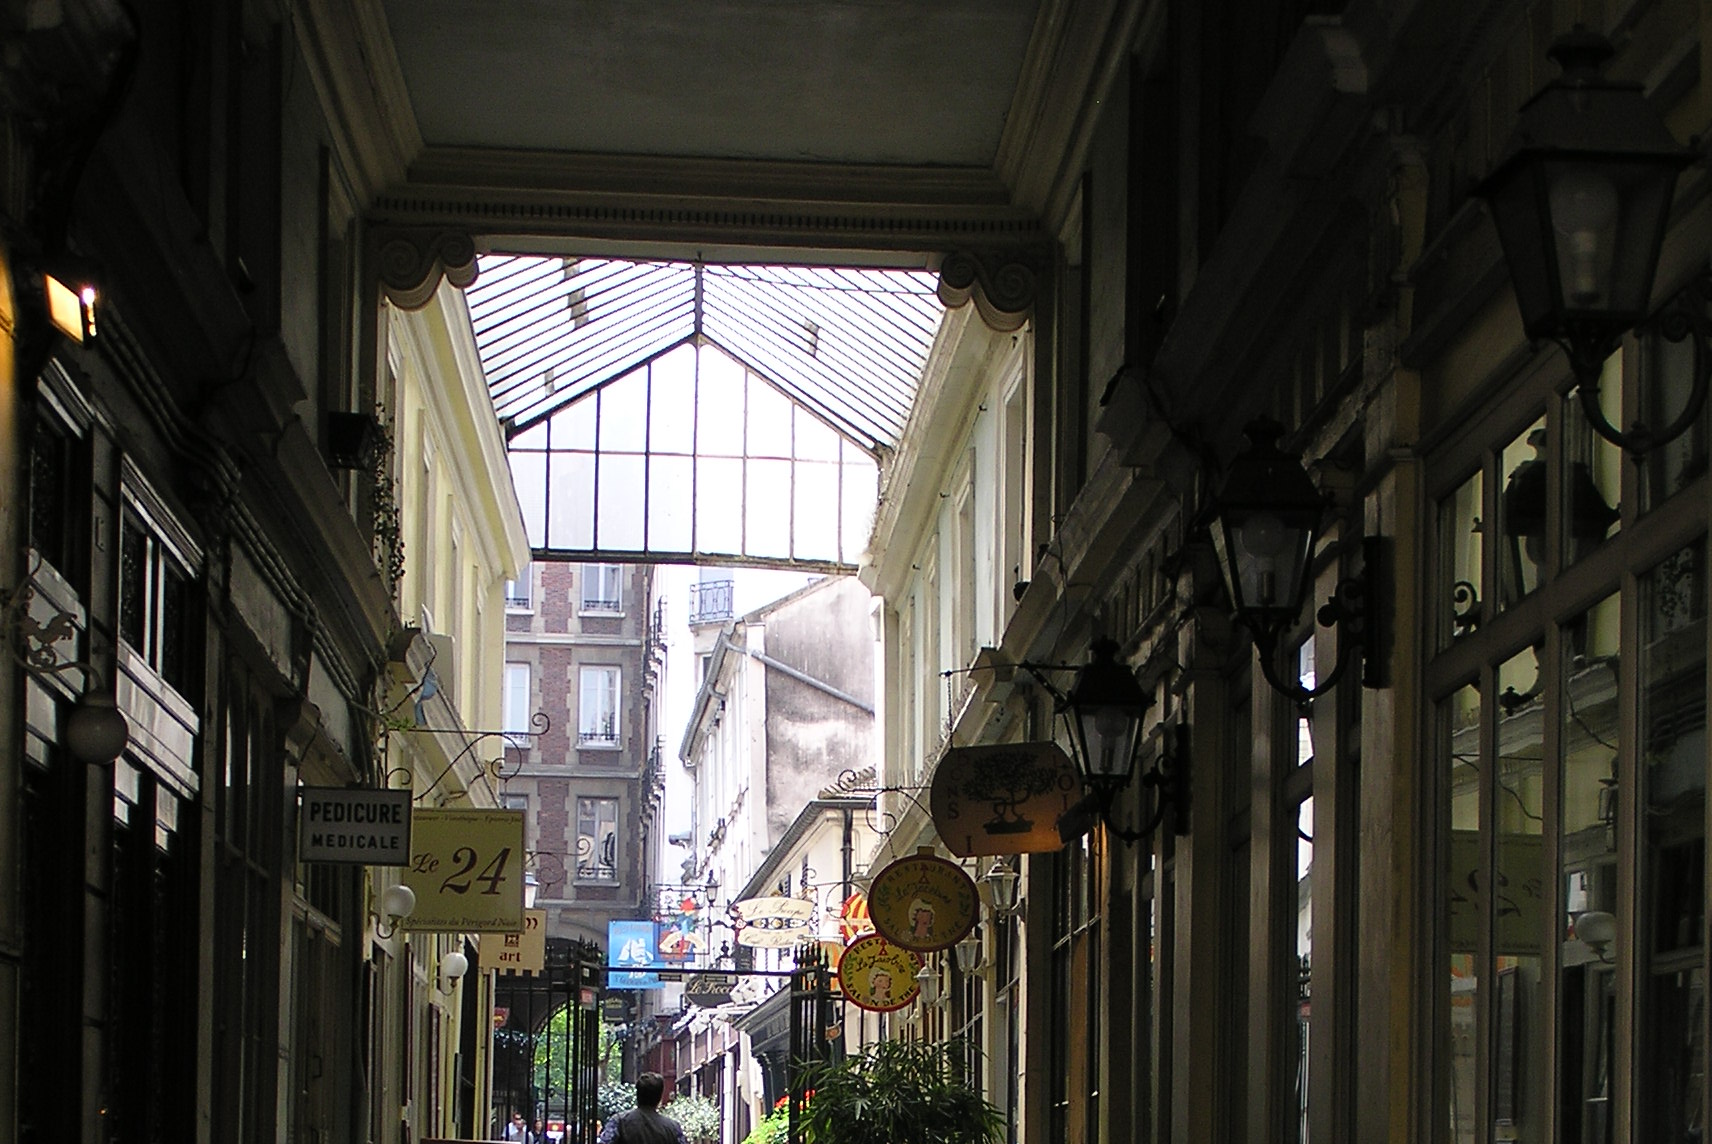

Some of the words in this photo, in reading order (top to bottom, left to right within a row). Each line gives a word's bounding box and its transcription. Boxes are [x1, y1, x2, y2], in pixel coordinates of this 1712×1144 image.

[310, 801, 402, 824] PEDICURE
[311, 834, 400, 850] MEDICALE
[412, 852, 440, 873] Le
[439, 846, 512, 895] 24
[498, 952, 521, 962] art
